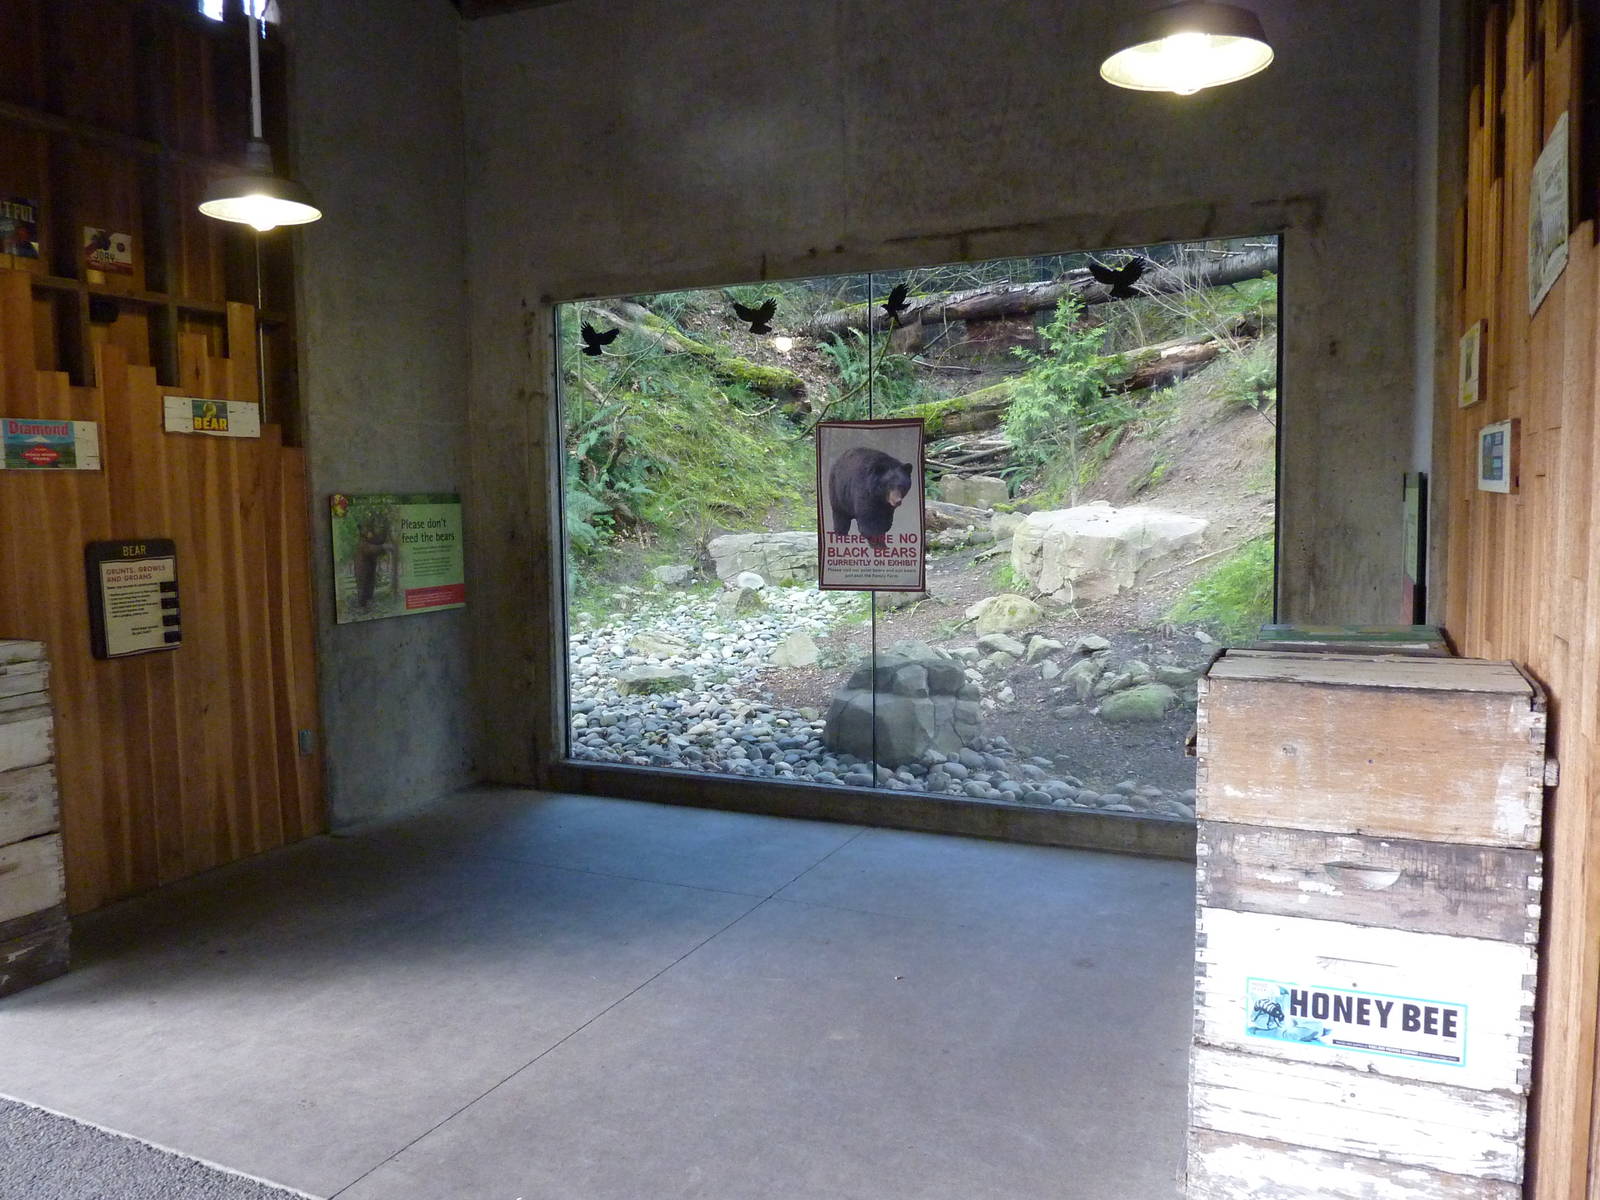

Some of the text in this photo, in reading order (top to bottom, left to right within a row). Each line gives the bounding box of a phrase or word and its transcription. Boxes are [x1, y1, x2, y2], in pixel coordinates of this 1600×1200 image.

[8, 421, 69, 436] Diamond
[193, 416, 228, 432] BEAR
[401, 518, 447, 529] Please don't
[402, 531, 456, 544] feed the bears
[869, 534, 894, 544] ARE
[899, 533, 918, 544] NO
[123, 545, 147, 556] BEAR
[827, 546, 918, 558] BLACK BEARS
[827, 559, 918, 567] CURRENTLY ON EXHIBIT
[1290, 988, 1458, 1039] HONEY BEE
